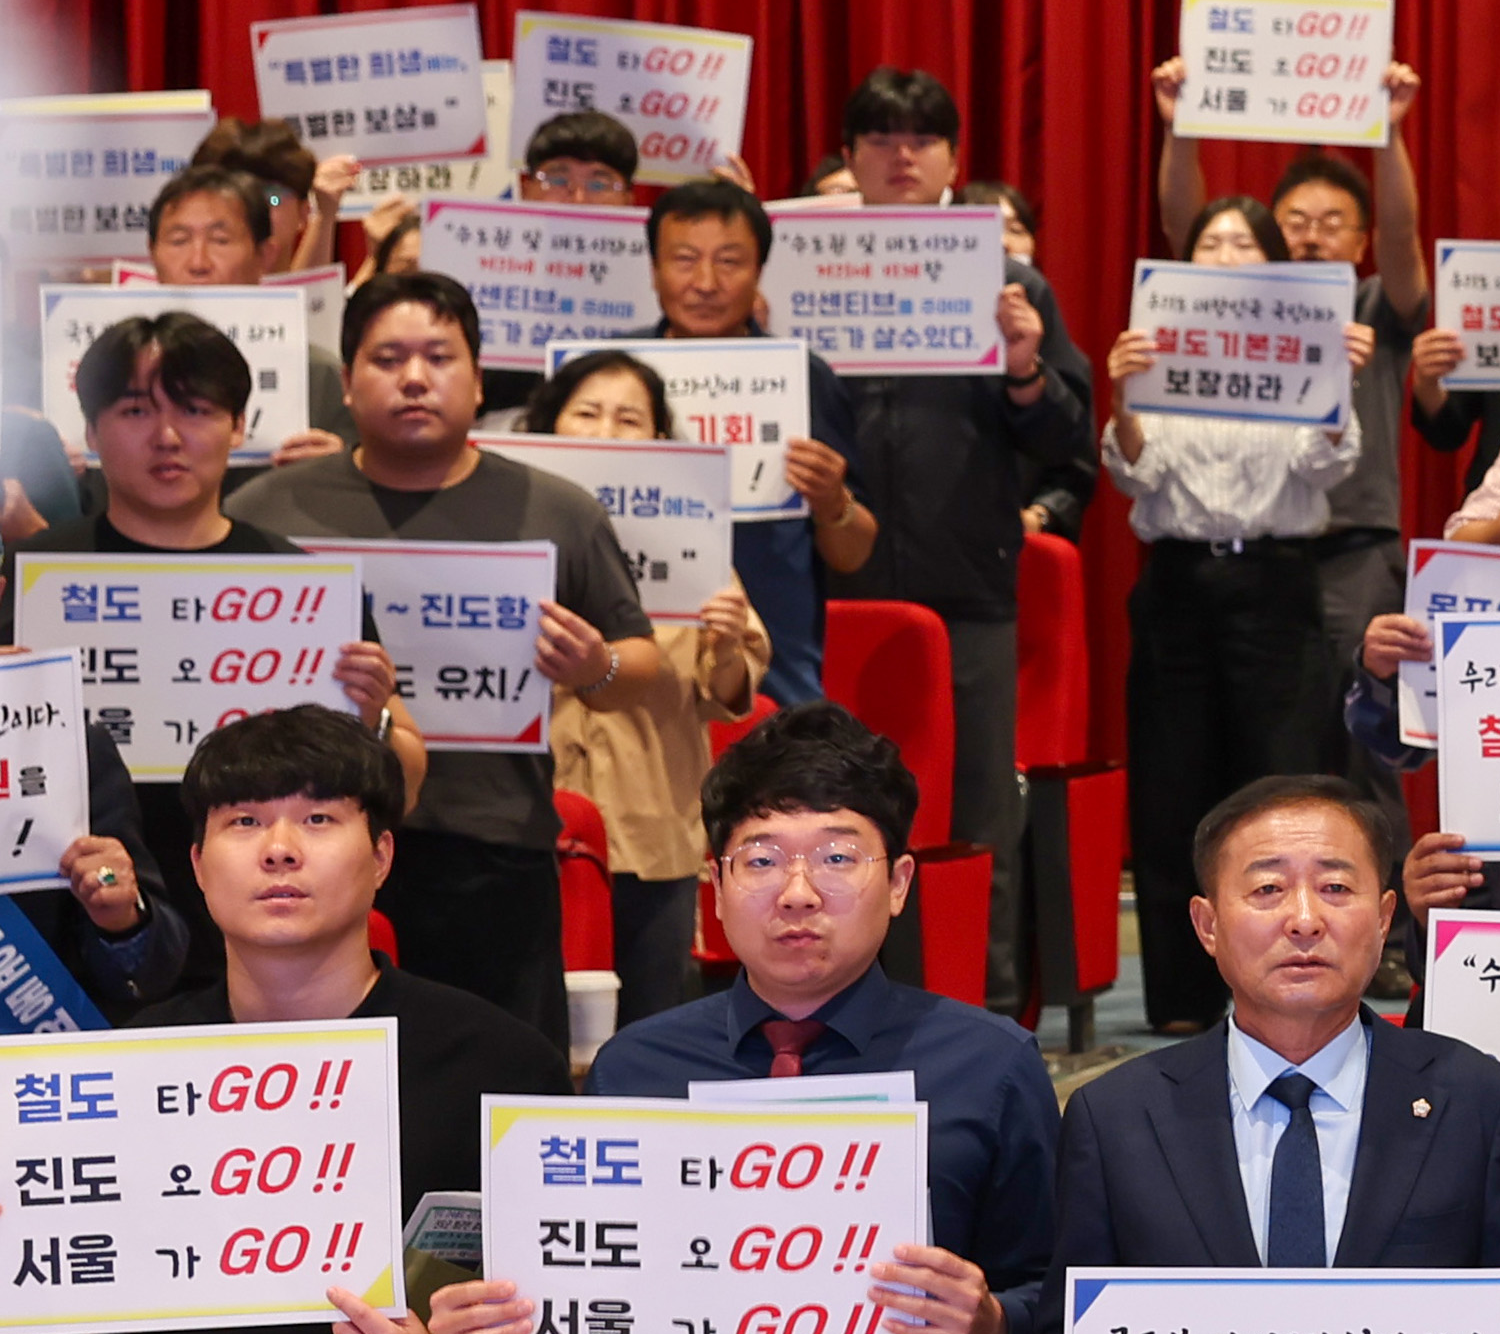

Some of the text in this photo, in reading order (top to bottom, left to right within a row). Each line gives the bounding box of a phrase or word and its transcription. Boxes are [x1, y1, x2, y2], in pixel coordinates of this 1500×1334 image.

[1205, 48, 1252, 74] 진도
[1164, 367, 1282, 402] 보장하라
[62, 584, 141, 622] 철도
[420, 594, 530, 630] 진도항
[435, 665, 531, 702] 유치!
[15, 1072, 118, 1124] 철도
[15, 1156, 121, 1207] 진도
[540, 1137, 642, 1185] 철도
[13, 1234, 117, 1286] 서울
[540, 1221, 641, 1268] 진도
